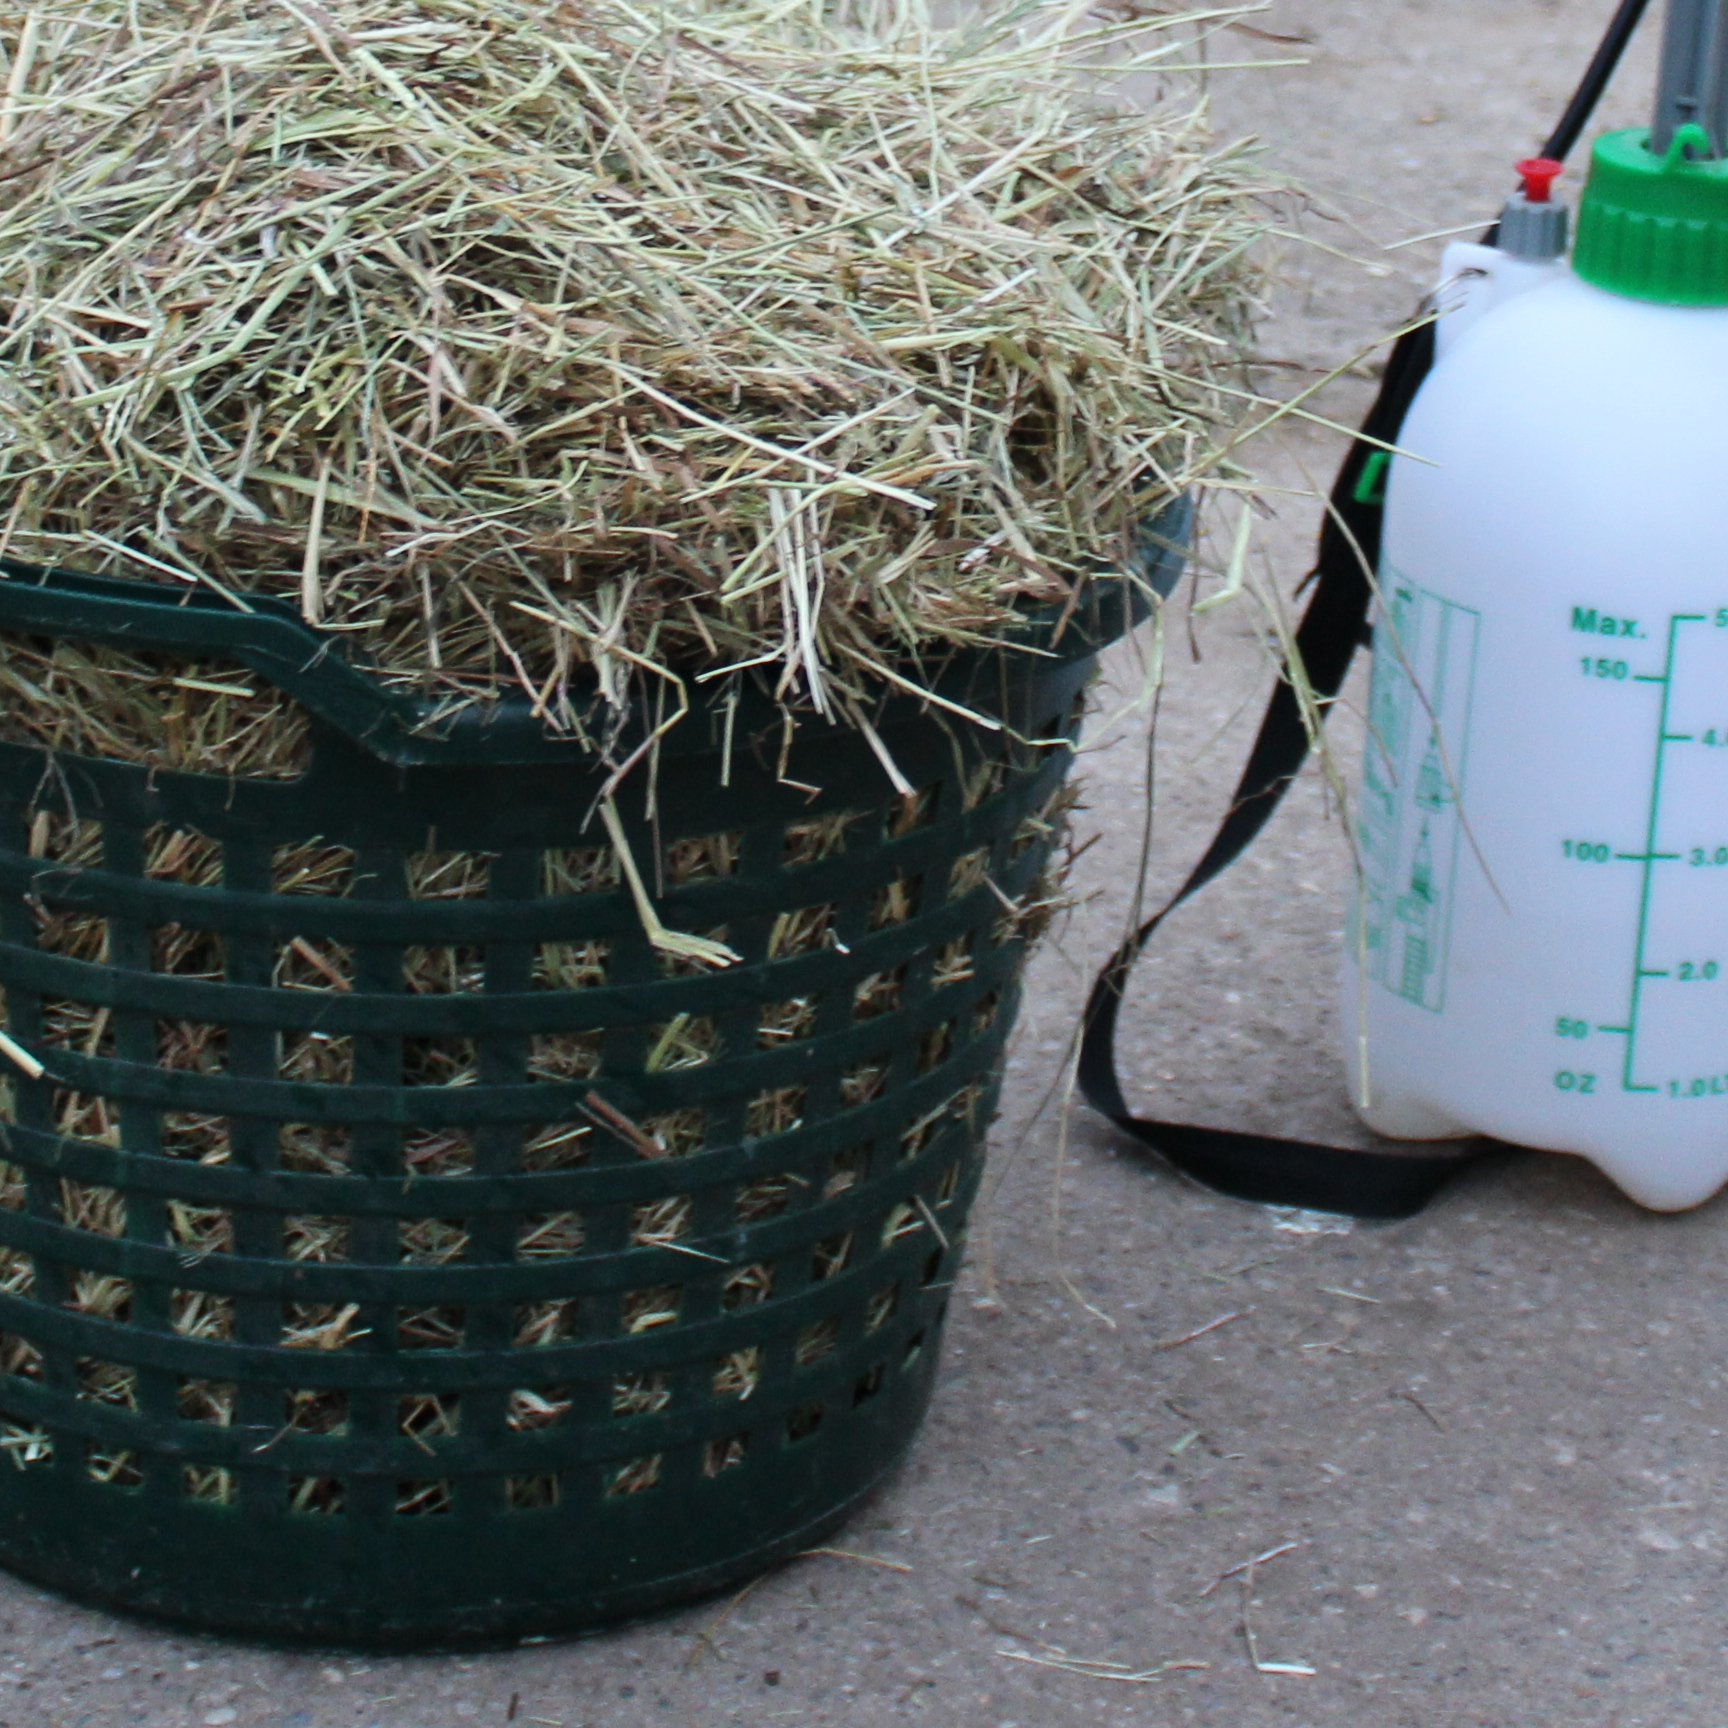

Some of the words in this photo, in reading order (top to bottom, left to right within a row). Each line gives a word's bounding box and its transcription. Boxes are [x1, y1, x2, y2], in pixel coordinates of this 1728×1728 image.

[1571, 606, 1647, 639] Max.
[1580, 657, 1628, 680] 150
[1562, 839, 1610, 863] 100
[1677, 960, 1718, 982] 2.0
[1555, 1017, 1588, 1039] 50
[1554, 1071, 1596, 1094] OZ
